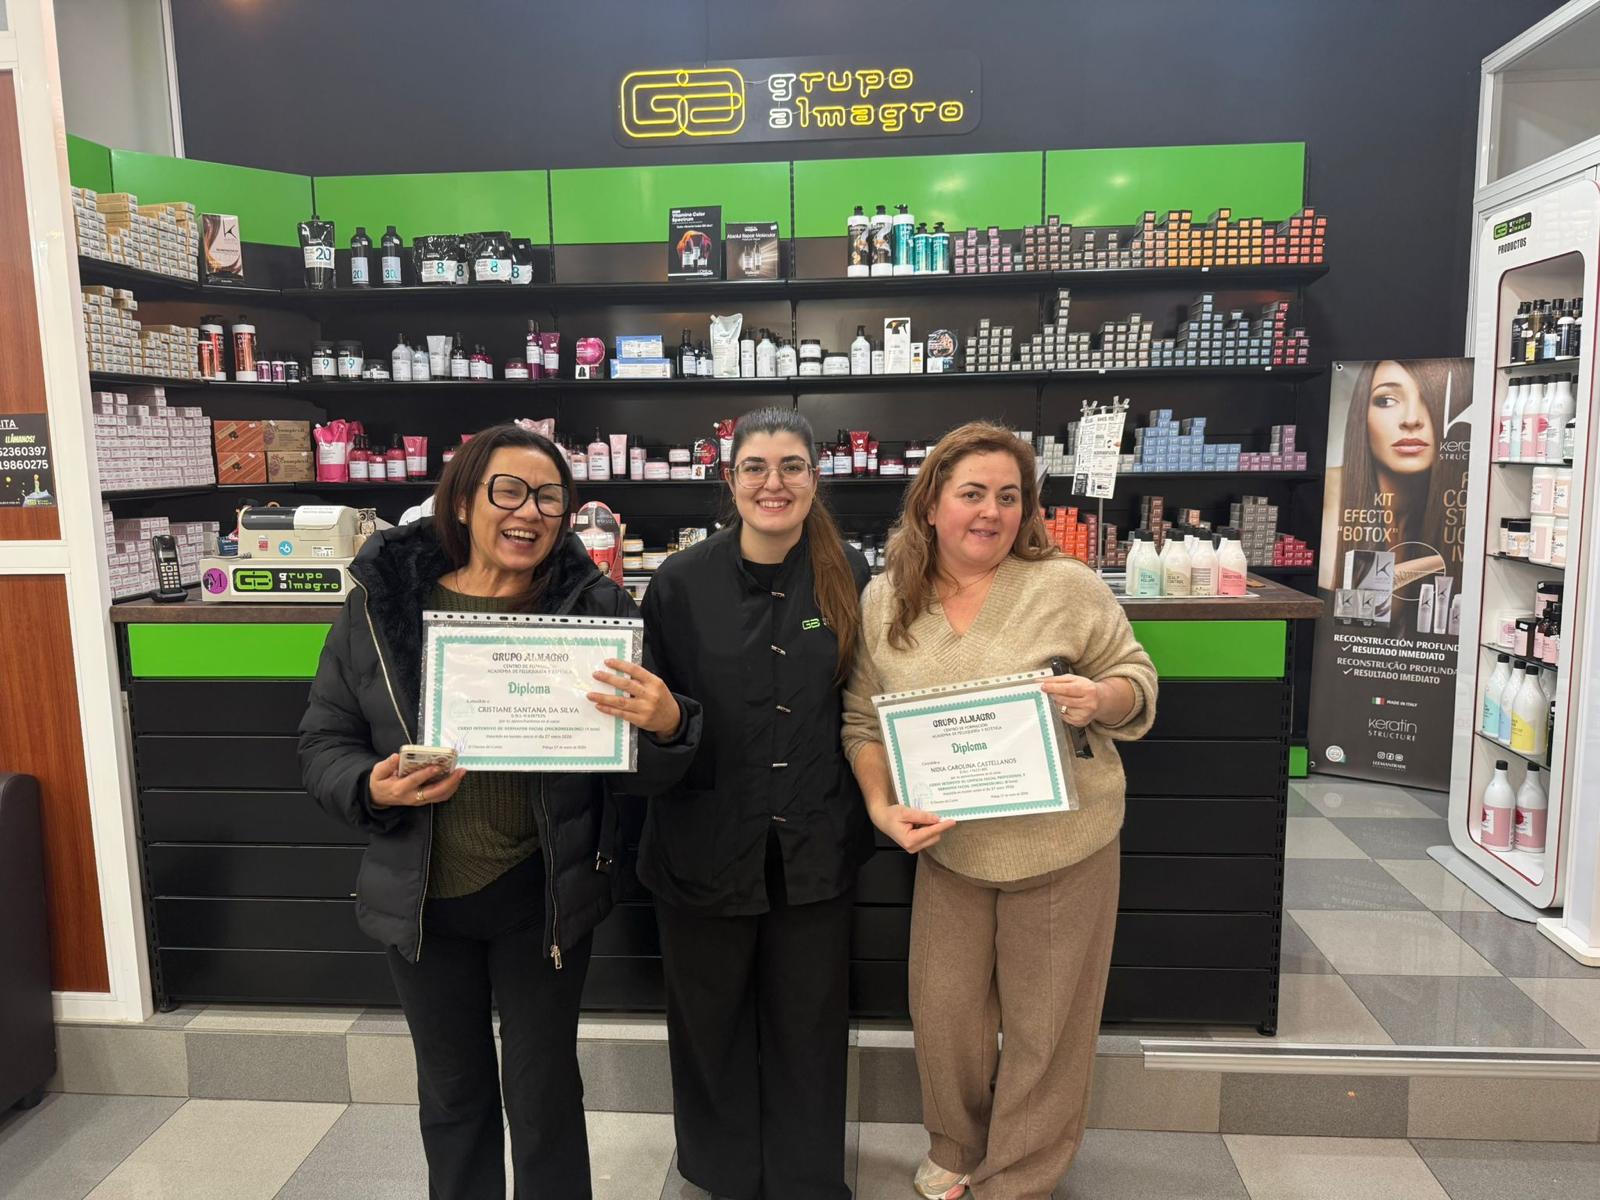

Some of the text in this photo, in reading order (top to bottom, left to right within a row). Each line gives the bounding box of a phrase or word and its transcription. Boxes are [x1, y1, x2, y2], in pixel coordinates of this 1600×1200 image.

[768, 68, 913, 101] grupo
[769, 97, 964, 132] almagro
[1498, 237, 1527, 255] PRODUCTOS
[316, 248, 332, 260] 20
[436, 262, 444, 274] 8
[456, 264, 464, 277] 8
[490, 260, 498, 272] 8
[512, 266, 520, 278] 8
[322, 358, 330, 369] 9
[1374, 493, 1394, 506] KIT
[1344, 509, 1393, 524] EFECTO
[1338, 526, 1398, 542] "BOTOX"
[279, 571, 323, 581] grupo
[280, 581, 339, 591] almagro
[1334, 634, 1414, 648] RECONSTRUCCIÓN
[492, 652, 569, 662] GRUPO ALMAGRO
[1352, 646, 1445, 661] RESULTADO INMEDIATO
[1337, 657, 1406, 670] RECONSTRUÇÃO
[1353, 669, 1440, 684] RESULTADO IMEDIATO
[508, 681, 550, 696] Diploma
[933, 712, 996, 728] GRUPO ALMAGRO
[1368, 719, 1417, 733] keratin
[1368, 730, 1416, 742] STRUCTURE
[952, 742, 987, 755] Diploma
[947, 763, 976, 771] CAROLINA
[977, 758, 1016, 768] CASTELLANOS
